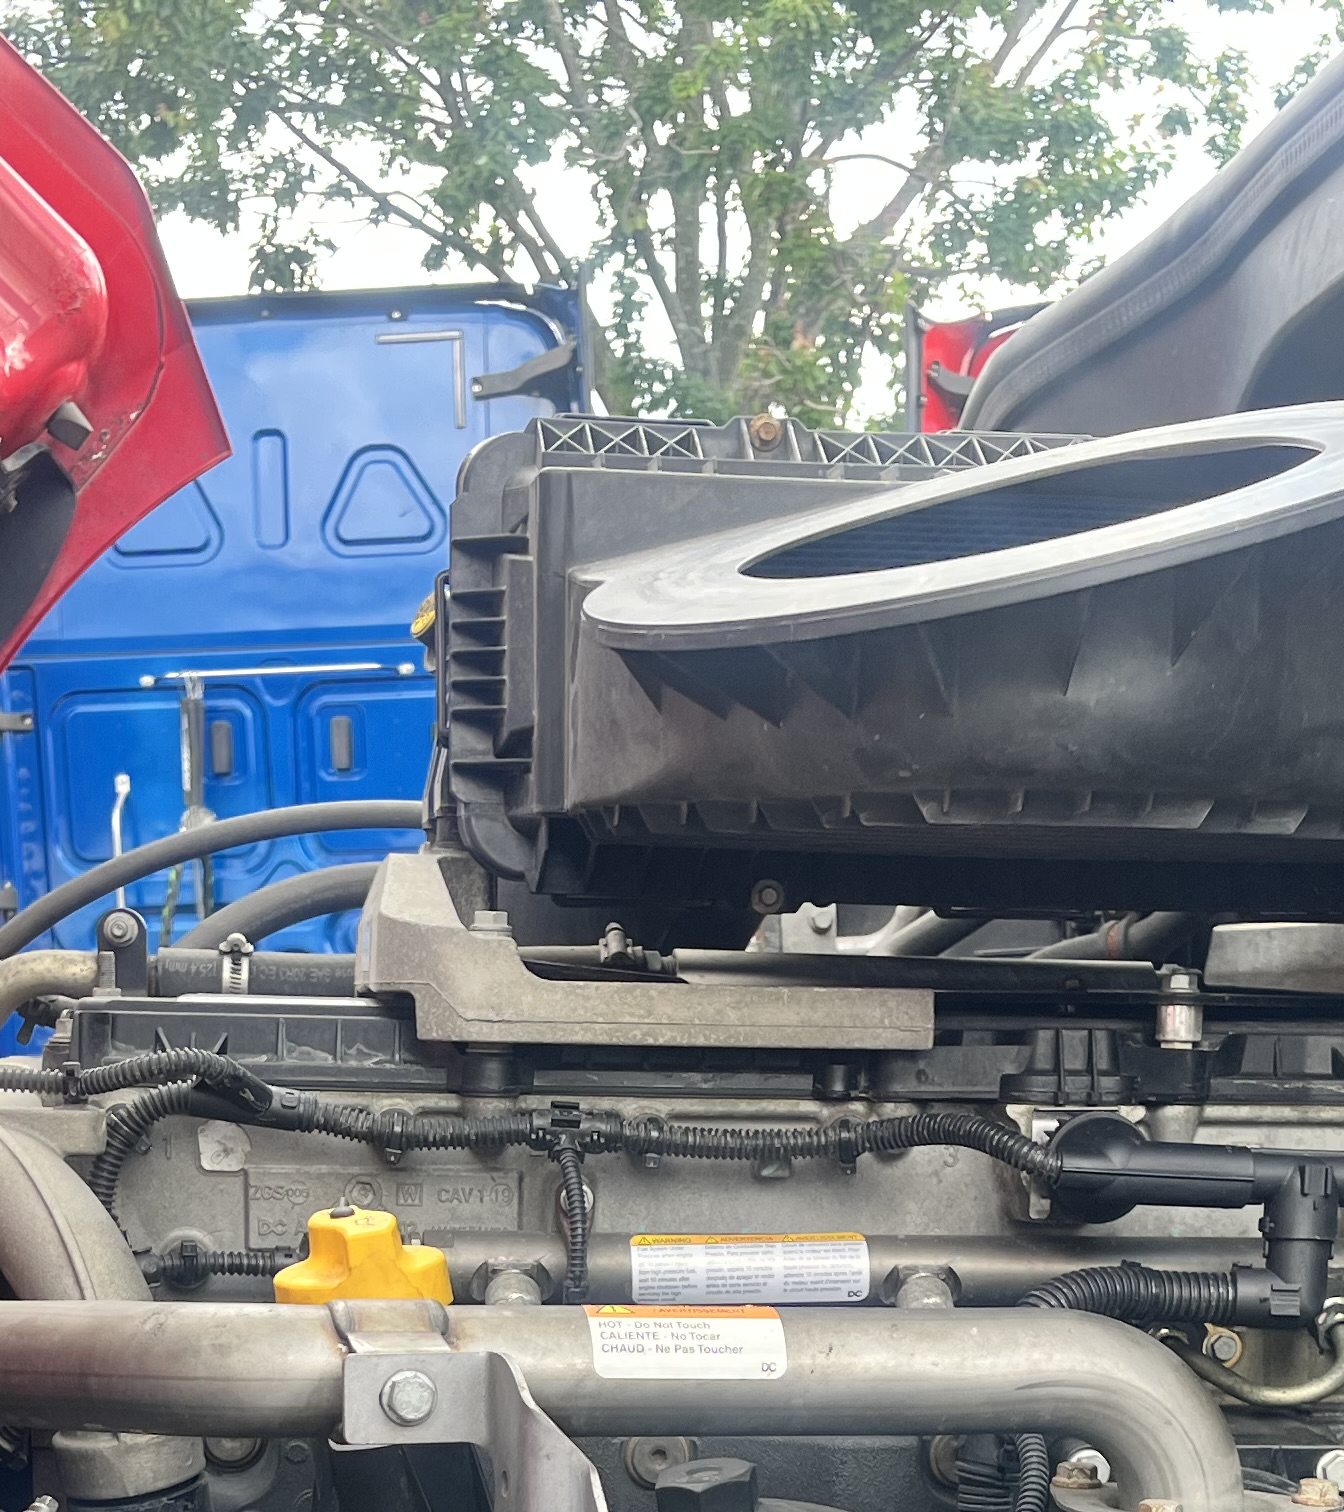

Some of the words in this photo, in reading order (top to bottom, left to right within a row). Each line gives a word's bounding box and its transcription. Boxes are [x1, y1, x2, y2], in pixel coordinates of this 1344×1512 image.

[437, 1187, 474, 1203] CAV
[847, 1290, 863, 1298] DC
[598, 1321, 623, 1329] HOT
[634, 1321, 650, 1329] Do
[654, 1321, 674, 1329] Not
[676, 1321, 711, 1329] Touch
[600, 1331, 660, 1341] CALIENTE
[671, 1332, 687, 1341] No
[690, 1332, 721, 1341] Tocar
[601, 1343, 645, 1353] CHAUD
[655, 1344, 671, 1353] Ne
[674, 1344, 695, 1354] Pas
[698, 1344, 744, 1354] Toucher
[761, 1362, 777, 1372] DC
